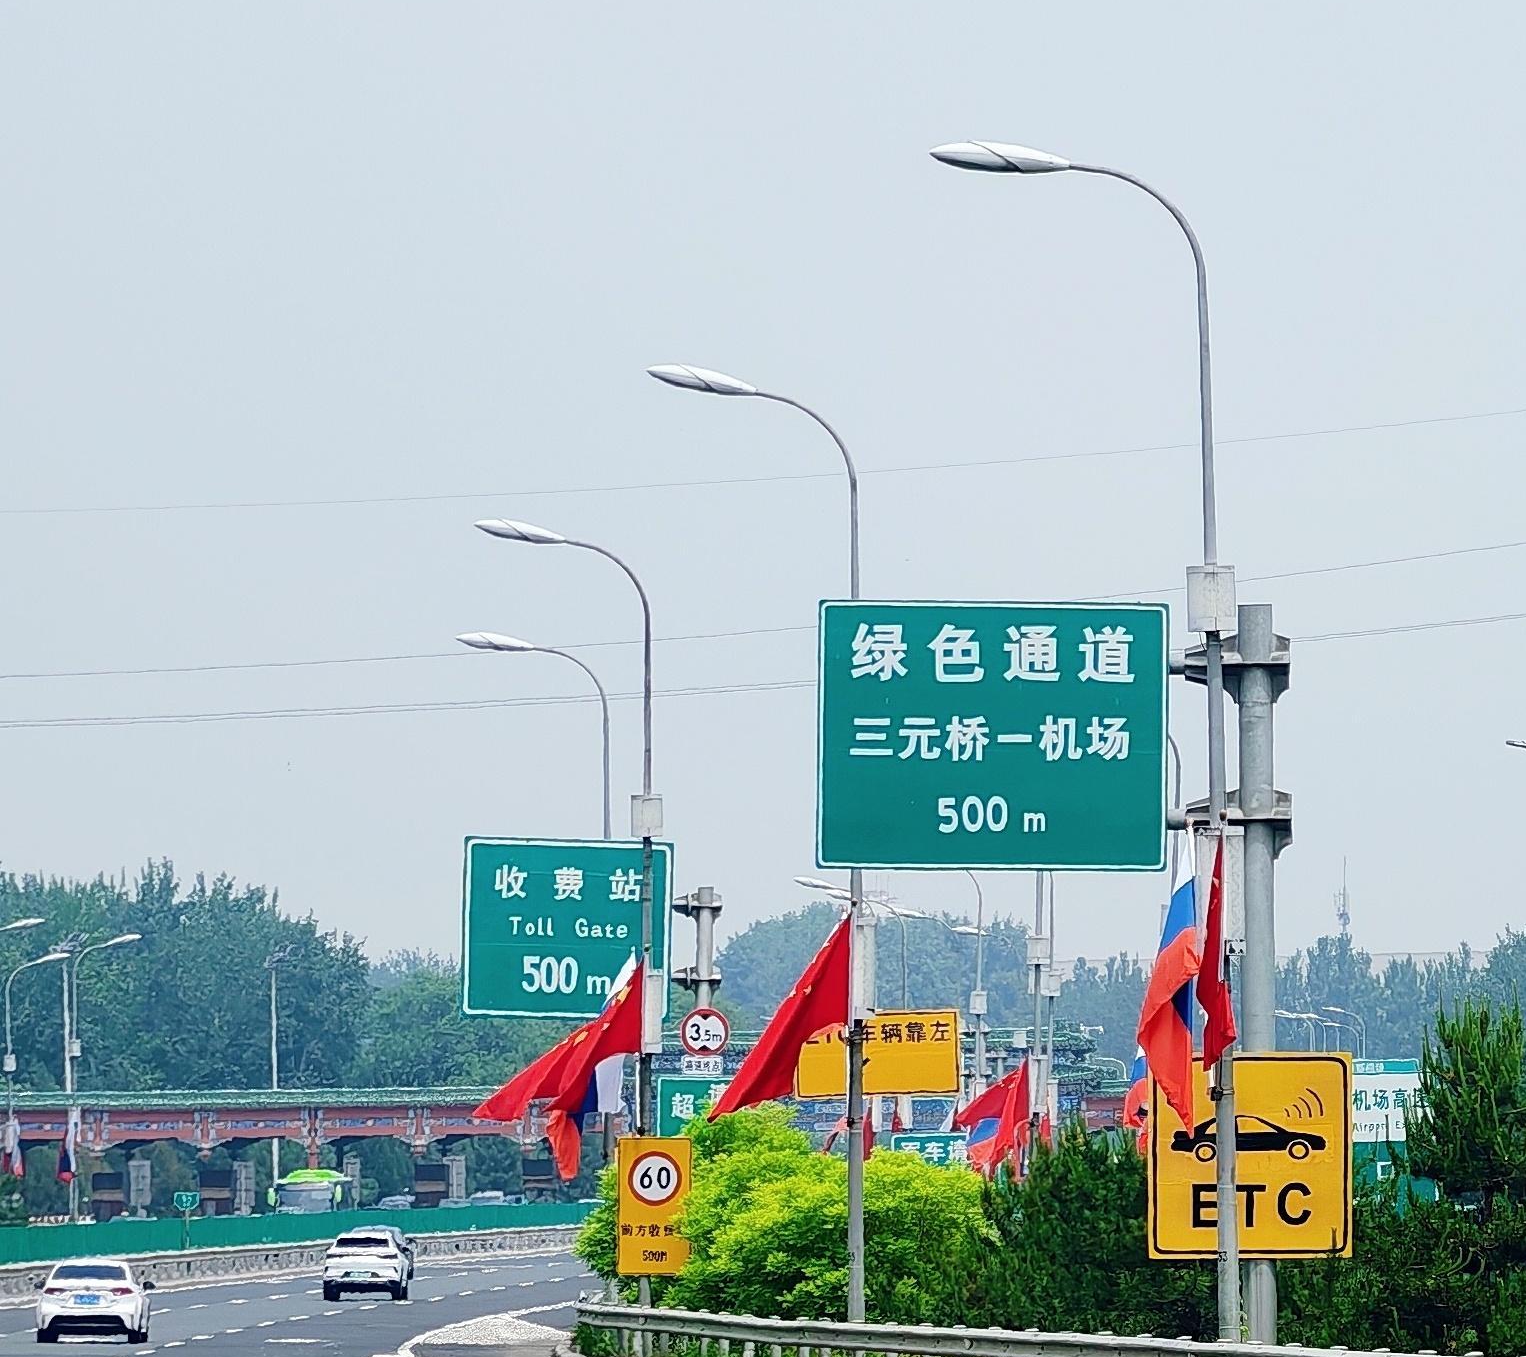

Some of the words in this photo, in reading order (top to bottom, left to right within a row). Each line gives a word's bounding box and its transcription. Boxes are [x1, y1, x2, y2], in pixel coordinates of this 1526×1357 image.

[851, 623, 1135, 683] 绿色通道
[938, 795, 1008, 833] 500
[1023, 812, 1046, 832] m
[494, 864, 643, 902] 收费站
[509, 916, 554, 937] Toll
[574, 918, 628, 939] Gate
[521, 955, 579, 994] 500
[586, 975, 610, 995] m
[688, 1023, 722, 1042] 3.5m
[639, 1166, 671, 1189] 60
[1192, 1182, 1312, 1226] ETC
